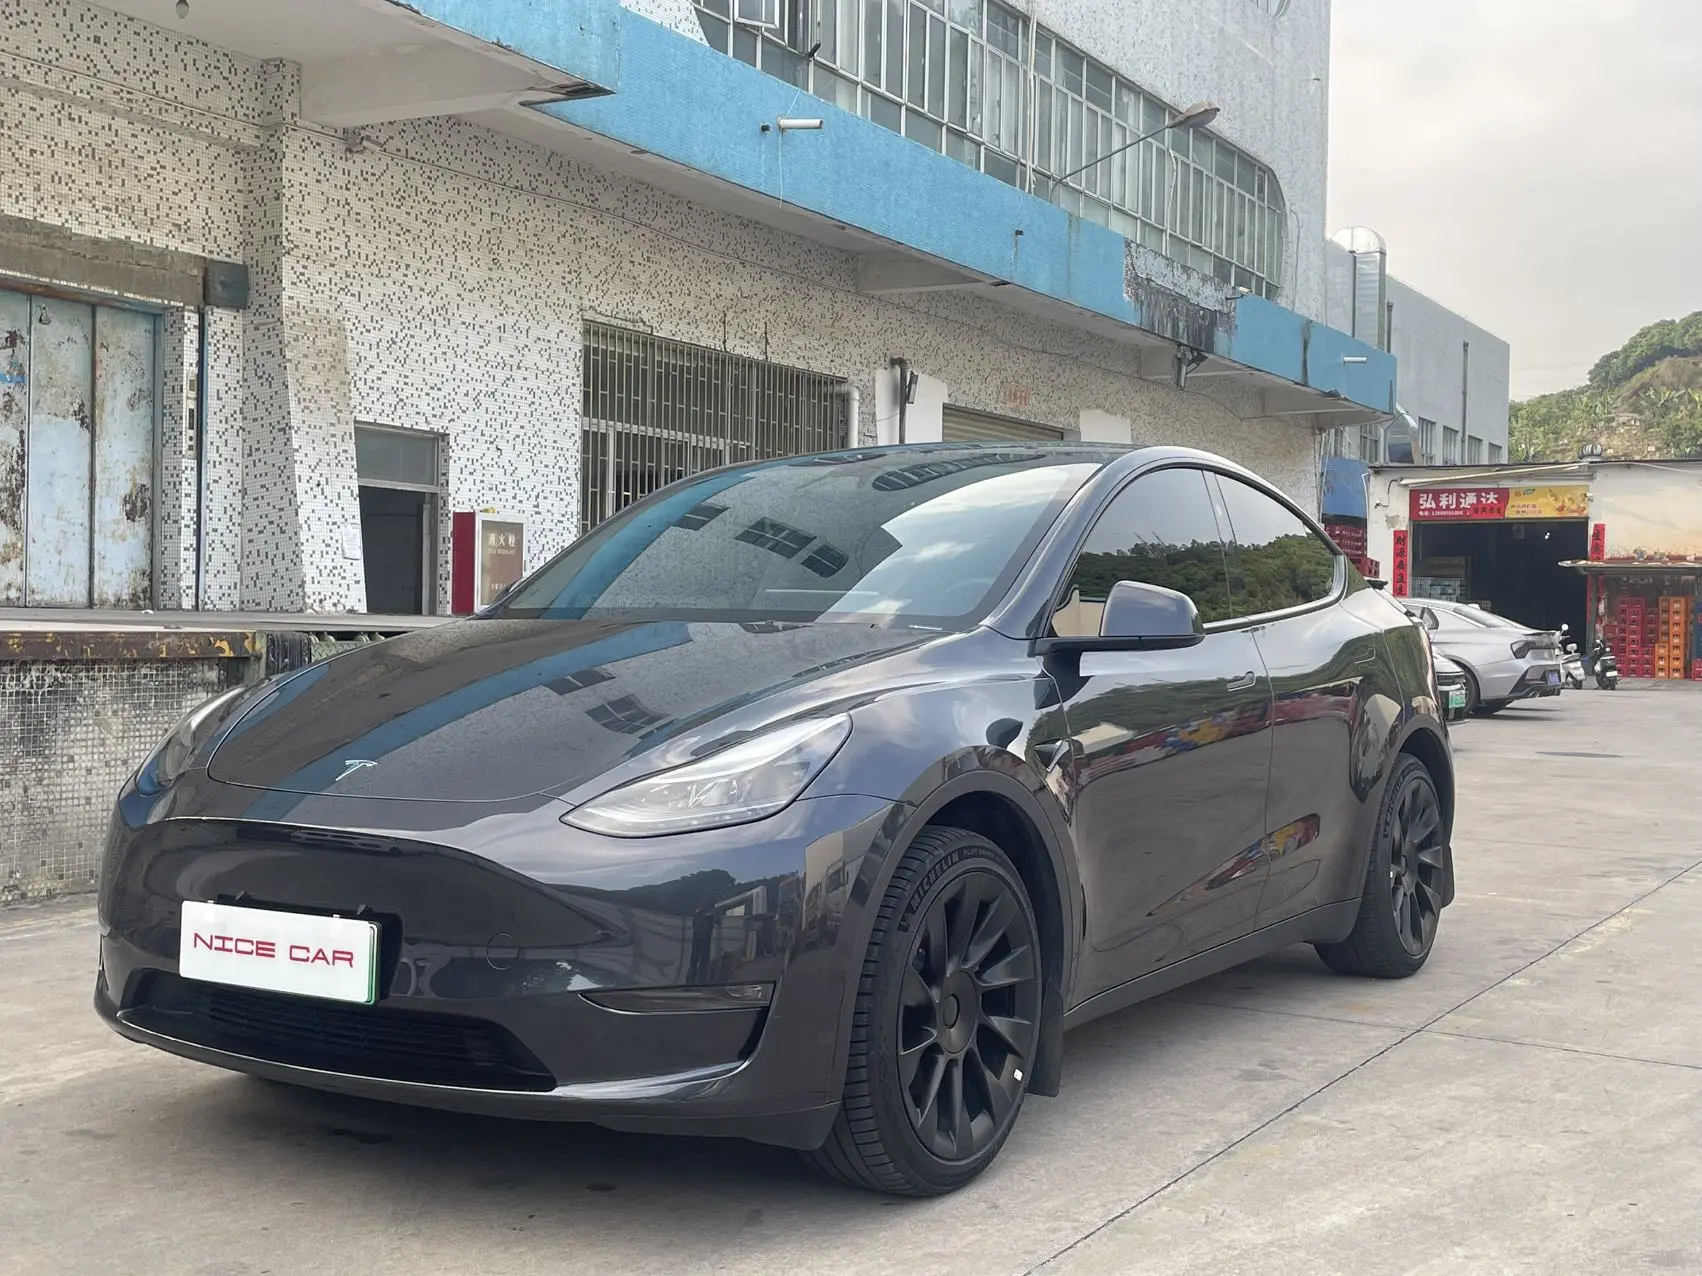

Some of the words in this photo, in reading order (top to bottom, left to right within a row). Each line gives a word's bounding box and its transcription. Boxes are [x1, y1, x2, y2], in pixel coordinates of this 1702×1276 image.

[909, 850, 961, 913] MICHELIN
[193, 932, 276, 959] NICE
[289, 944, 354, 969] CAR
